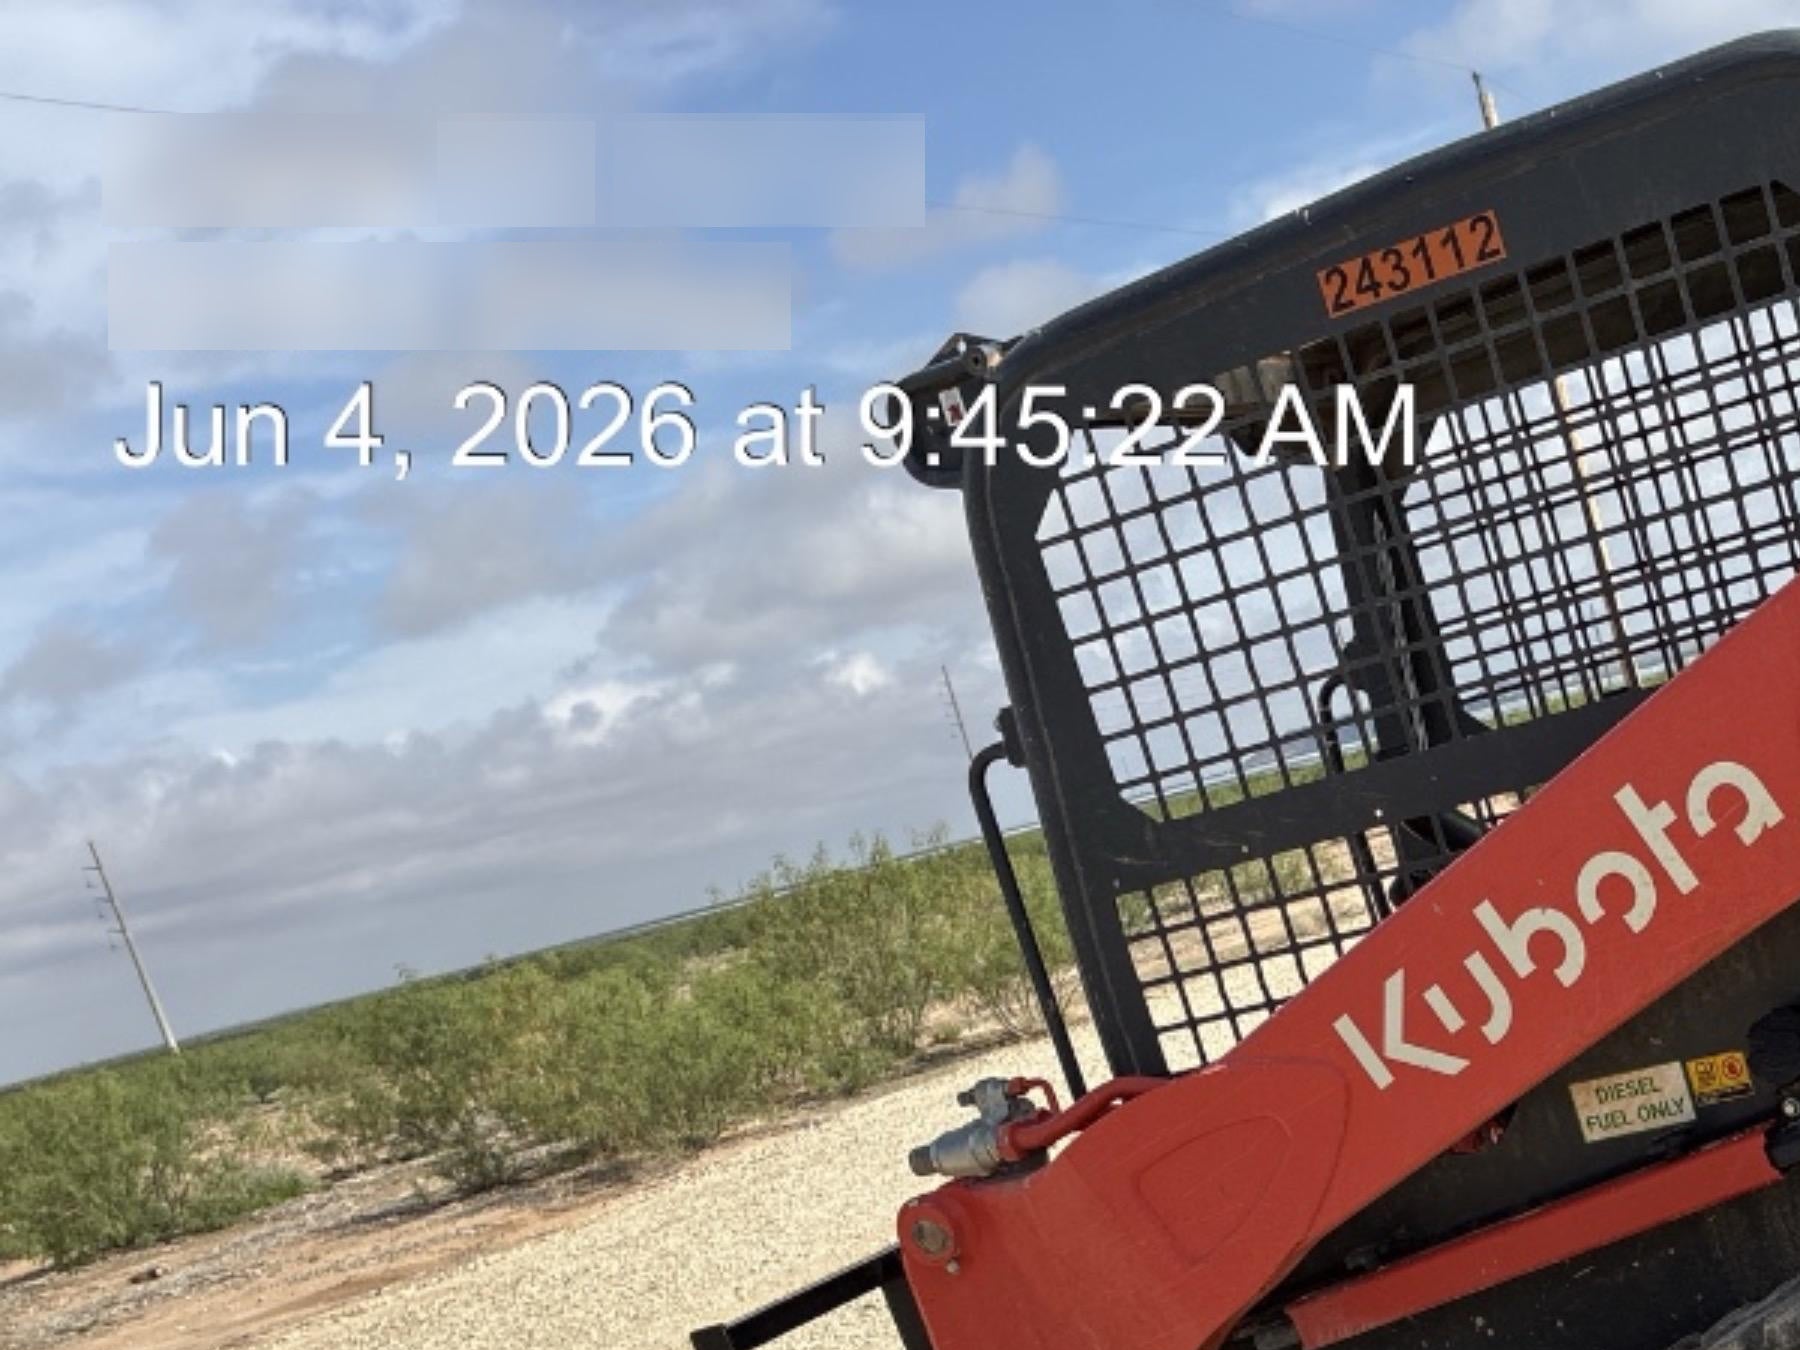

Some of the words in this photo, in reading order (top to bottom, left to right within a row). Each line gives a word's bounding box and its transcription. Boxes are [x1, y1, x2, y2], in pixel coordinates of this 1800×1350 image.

[1326, 215, 1500, 311] 243112
[1332, 761, 1785, 1090] Kubota
[1586, 1109, 1632, 1132] FUEL
[1637, 1097, 1685, 1123] ONLY
[1595, 1076, 1662, 1104] DIESEL
